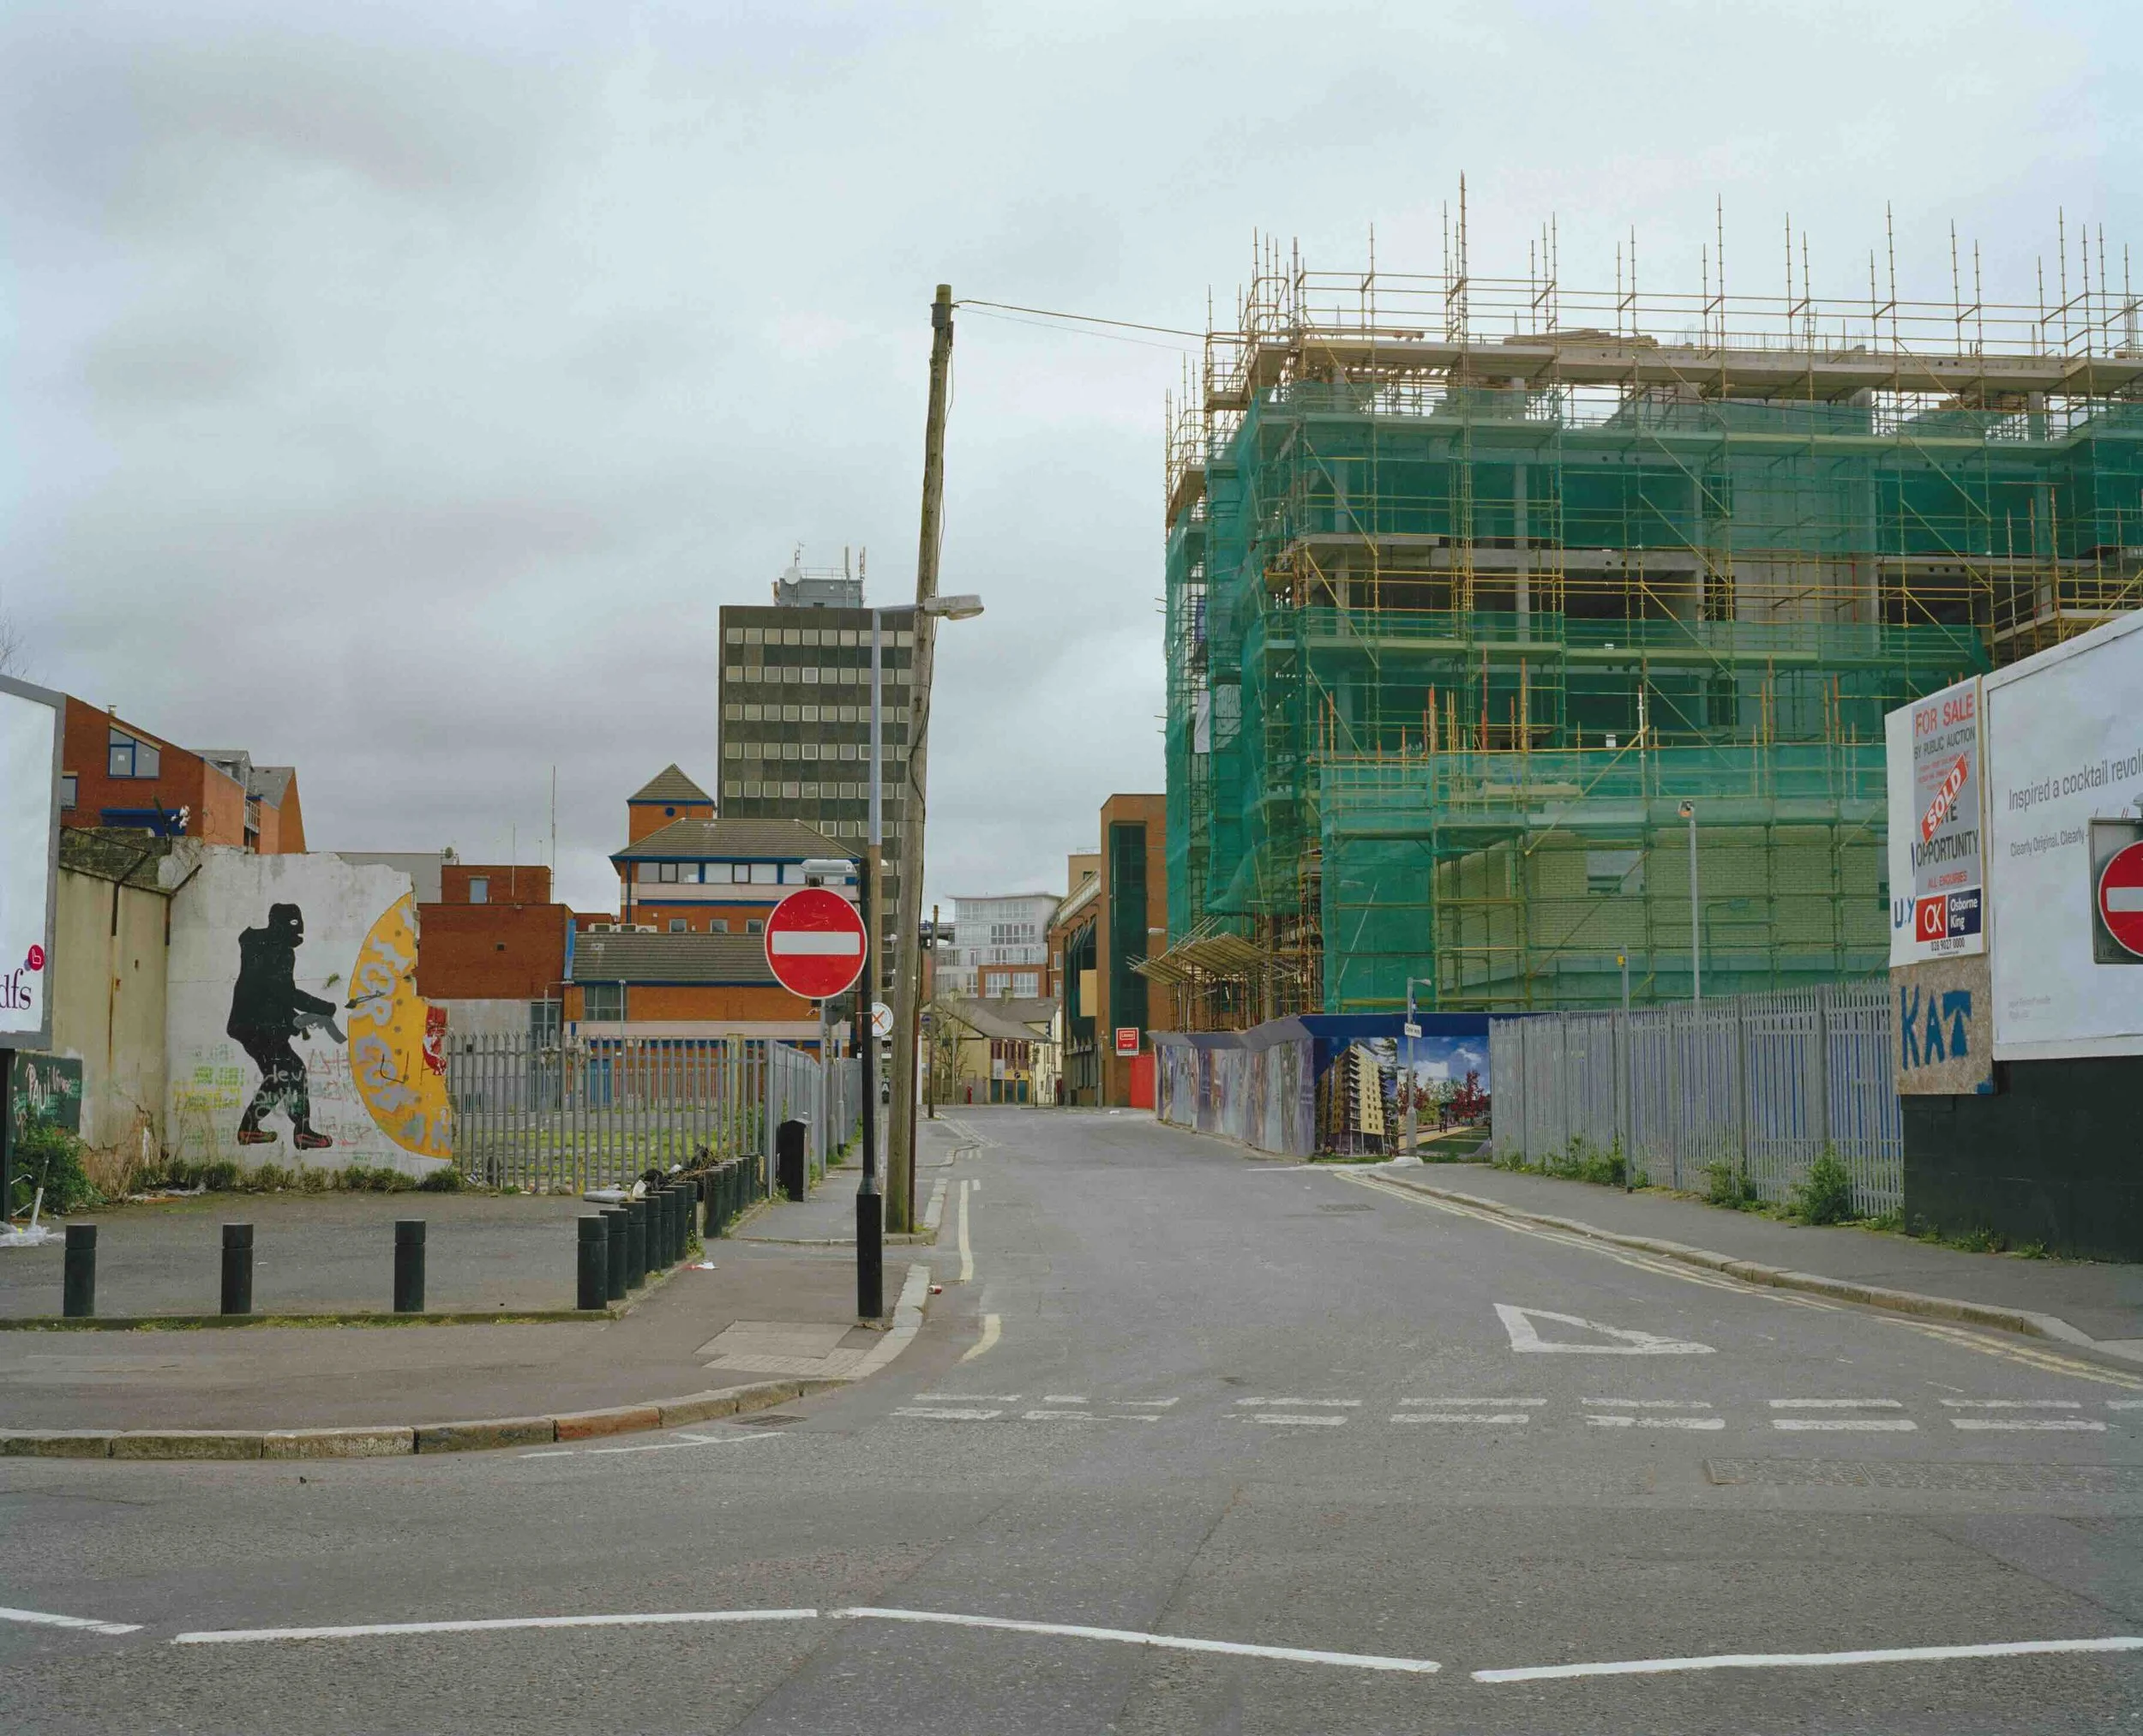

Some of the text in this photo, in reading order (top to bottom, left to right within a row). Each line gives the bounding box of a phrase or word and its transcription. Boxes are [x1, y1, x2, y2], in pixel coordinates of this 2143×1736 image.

[1915, 693, 1974, 738] FOR SALE
[1914, 725, 1975, 760] BY PUBLIC AUCTION
[1927, 767, 1961, 832] SOLD
[2008, 748, 2143, 813] Inspired a cocktail revol
[1916, 828, 1979, 868] OPPORTUNITY
[2010, 826, 2085, 858] Clearly Original. Clearly
[1928, 876, 1938, 889] ALL
[1950, 898, 1978, 912] Osborne
[1950, 914, 1965, 931] King
[0, 968, 32, 1010] dfs
[1900, 983, 1972, 1072] KAT
